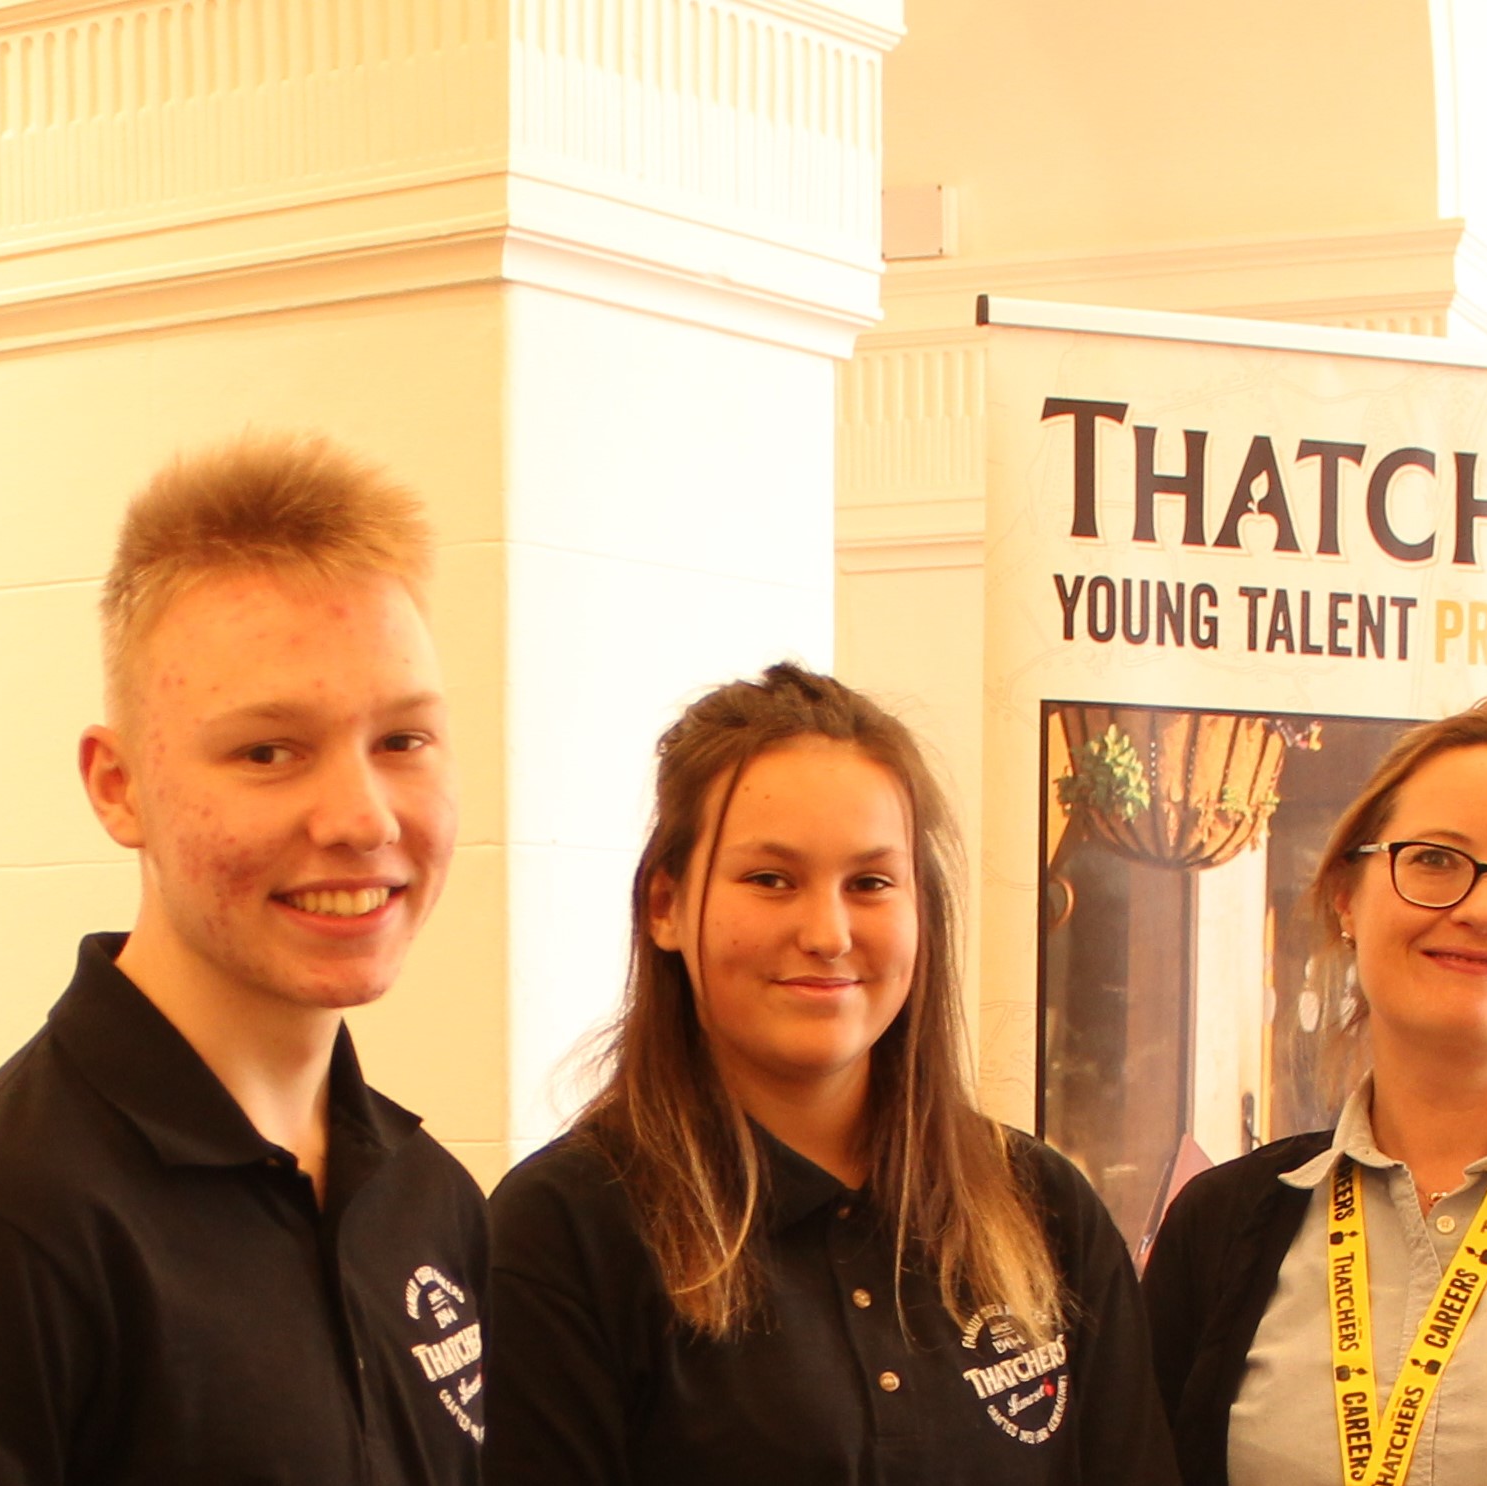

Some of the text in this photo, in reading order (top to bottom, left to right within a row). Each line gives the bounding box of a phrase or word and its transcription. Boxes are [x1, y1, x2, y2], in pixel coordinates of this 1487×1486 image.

[1053, 573, 1220, 651] YOUNG
[1238, 586, 1418, 661] TALENT
[1334, 1251, 1360, 1353] THATCHERS
[1424, 1267, 1481, 1351] CAREERS
[962, 1334, 1067, 1399] THATCHERS
